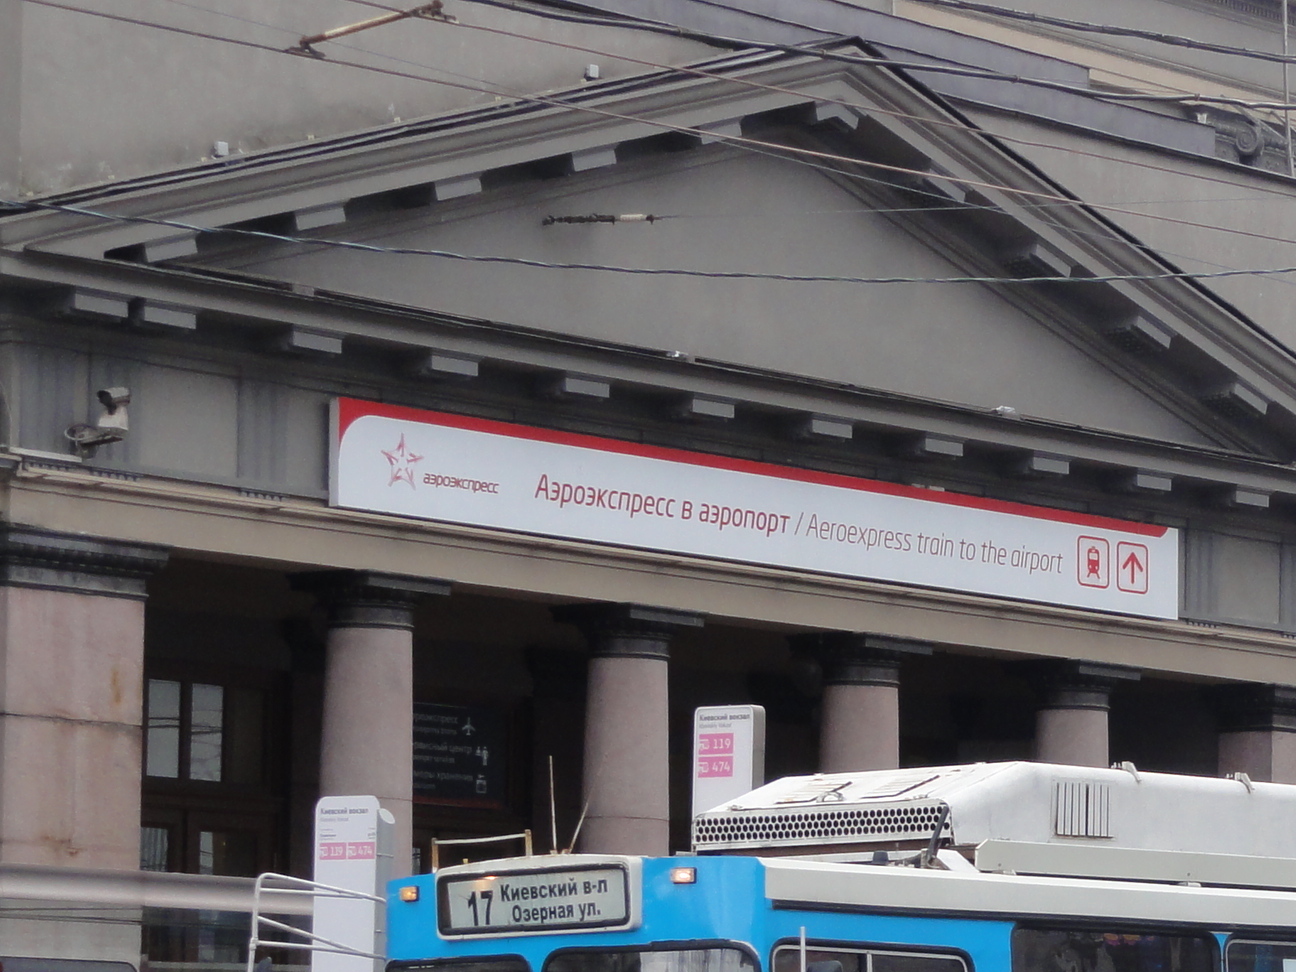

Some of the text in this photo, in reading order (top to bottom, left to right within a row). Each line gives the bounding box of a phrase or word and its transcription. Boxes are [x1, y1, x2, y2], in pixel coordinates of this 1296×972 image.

[423, 472, 499, 494] аэроэкспресс
[535, 473, 676, 518] Аэроэкспресс
[681, 500, 693, 521] в
[699, 503, 791, 538] аэропорт
[805, 513, 912, 552] Aeroexpress
[916, 532, 954, 559] train
[959, 537, 976, 562] to
[980, 540, 1007, 566] the
[1010, 544, 1063, 575] airport
[713, 738, 731, 749] 119
[712, 762, 730, 772] 474
[330, 845, 373, 856] 119 474
[501, 878, 578, 902] Киевский
[468, 890, 493, 926] 17
[512, 902, 601, 924] Озерная ул.
